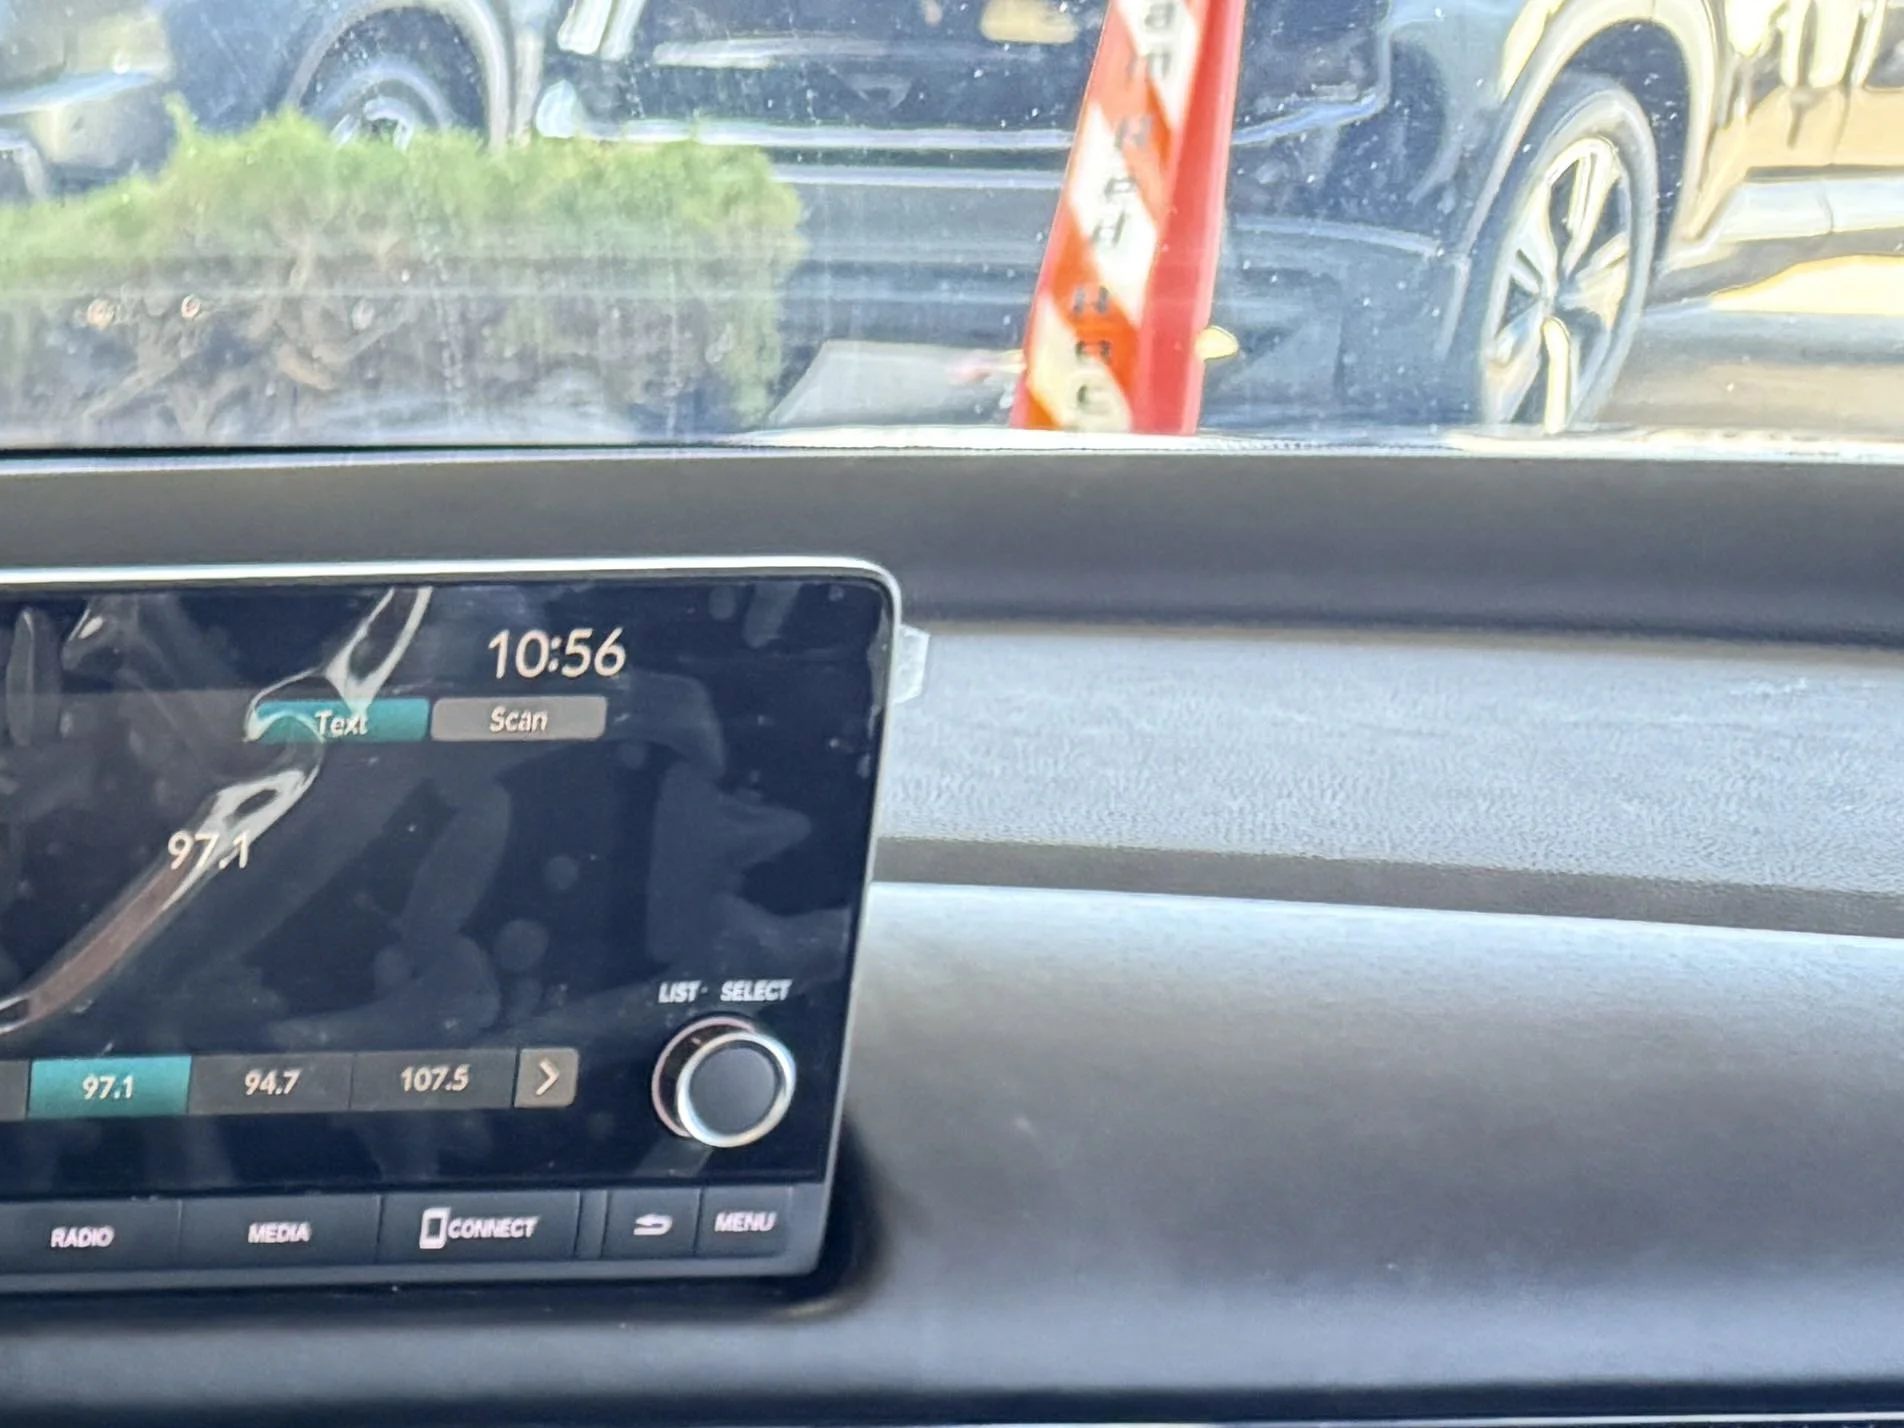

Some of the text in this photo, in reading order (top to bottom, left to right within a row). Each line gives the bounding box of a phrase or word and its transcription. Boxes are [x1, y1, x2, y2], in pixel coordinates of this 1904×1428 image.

[489, 627, 626, 679] 10:56
[315, 709, 369, 738] Text
[490, 706, 548, 735] Scan
[167, 829, 251, 871] 97.1
[658, 978, 793, 1003] LIST SELECT
[82, 1075, 134, 1099] 97.1
[244, 1068, 300, 1095] 94.7
[401, 1064, 470, 1092] 107.5
[248, 1221, 312, 1243] MEDIA
[447, 1215, 540, 1240] CONNECT
[714, 1211, 777, 1232] MENU
[50, 1226, 114, 1248] RADIO
